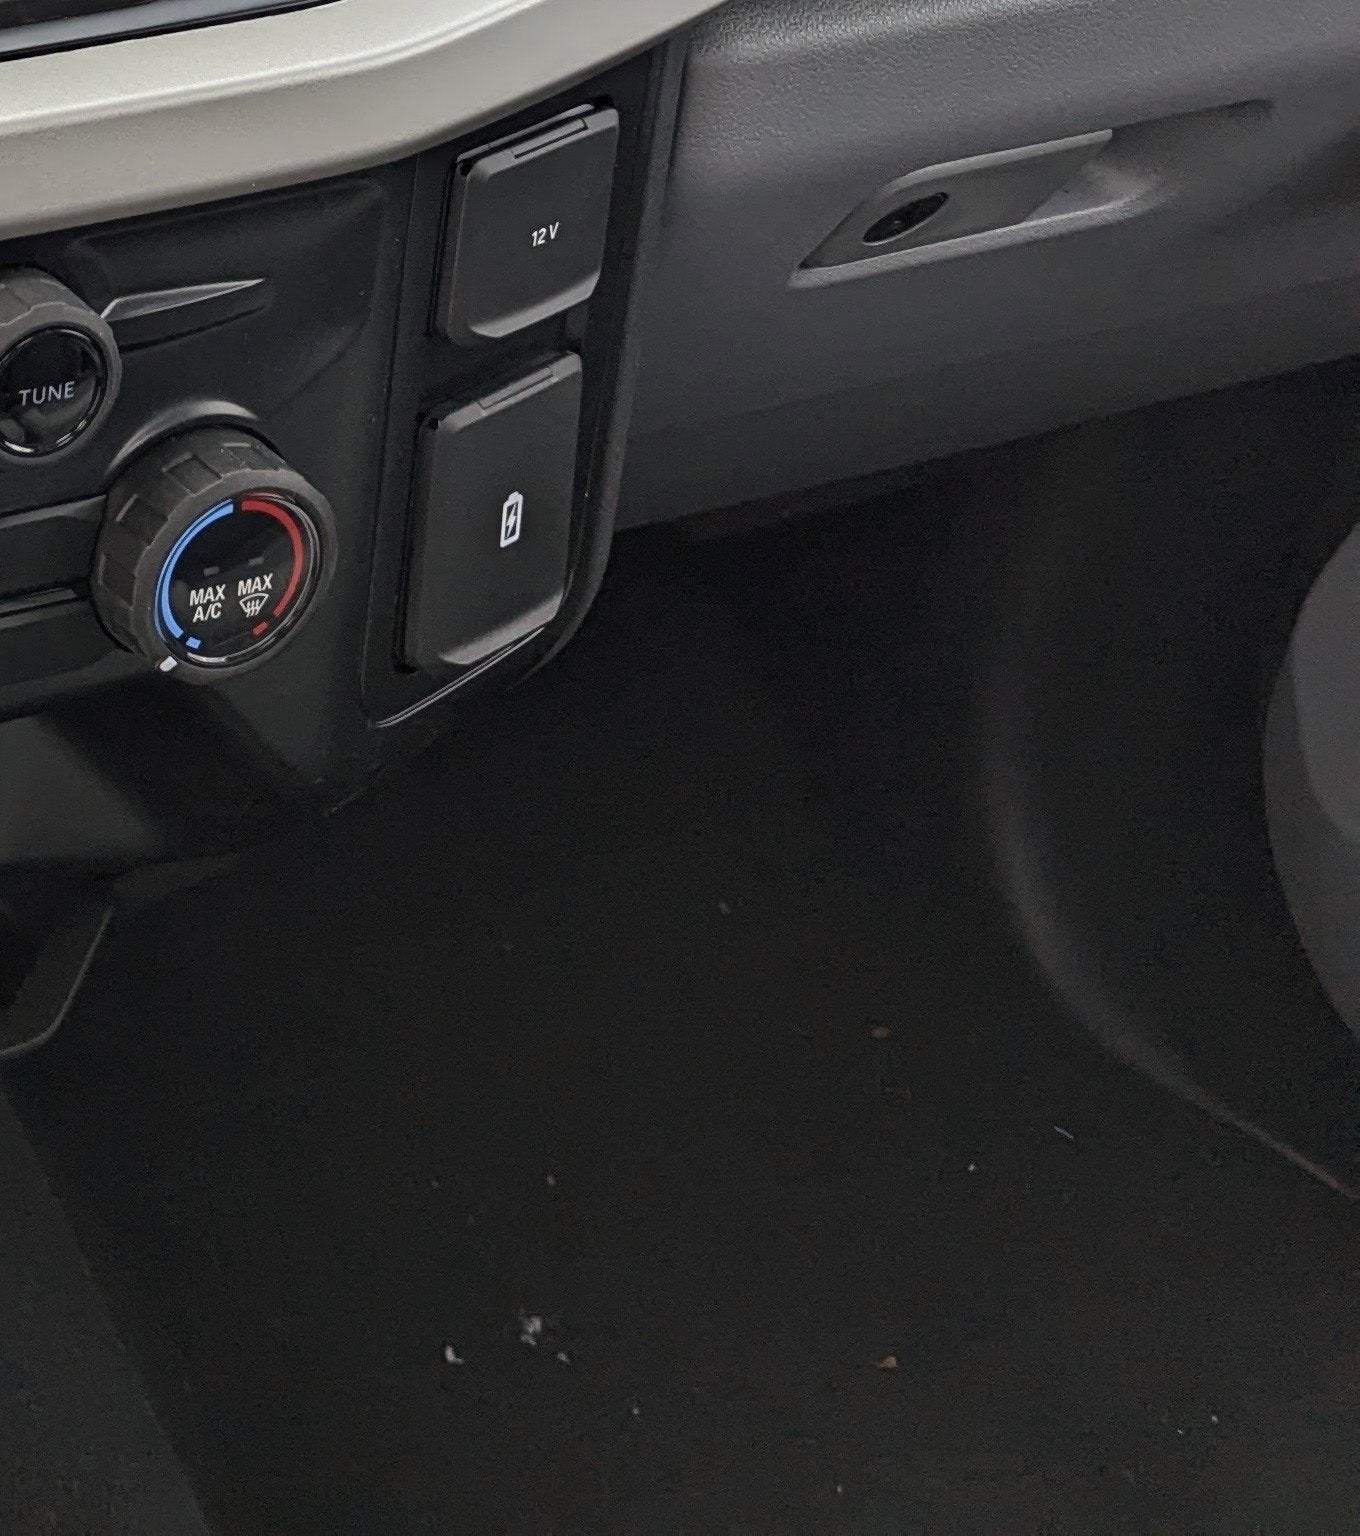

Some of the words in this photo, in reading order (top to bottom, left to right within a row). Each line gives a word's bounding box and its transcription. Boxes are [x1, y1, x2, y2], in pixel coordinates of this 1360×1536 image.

[18, 380, 76, 407] TUNE
[189, 582, 226, 607] MAX
[237, 571, 274, 596] MAX
[191, 600, 223, 623] A/C
